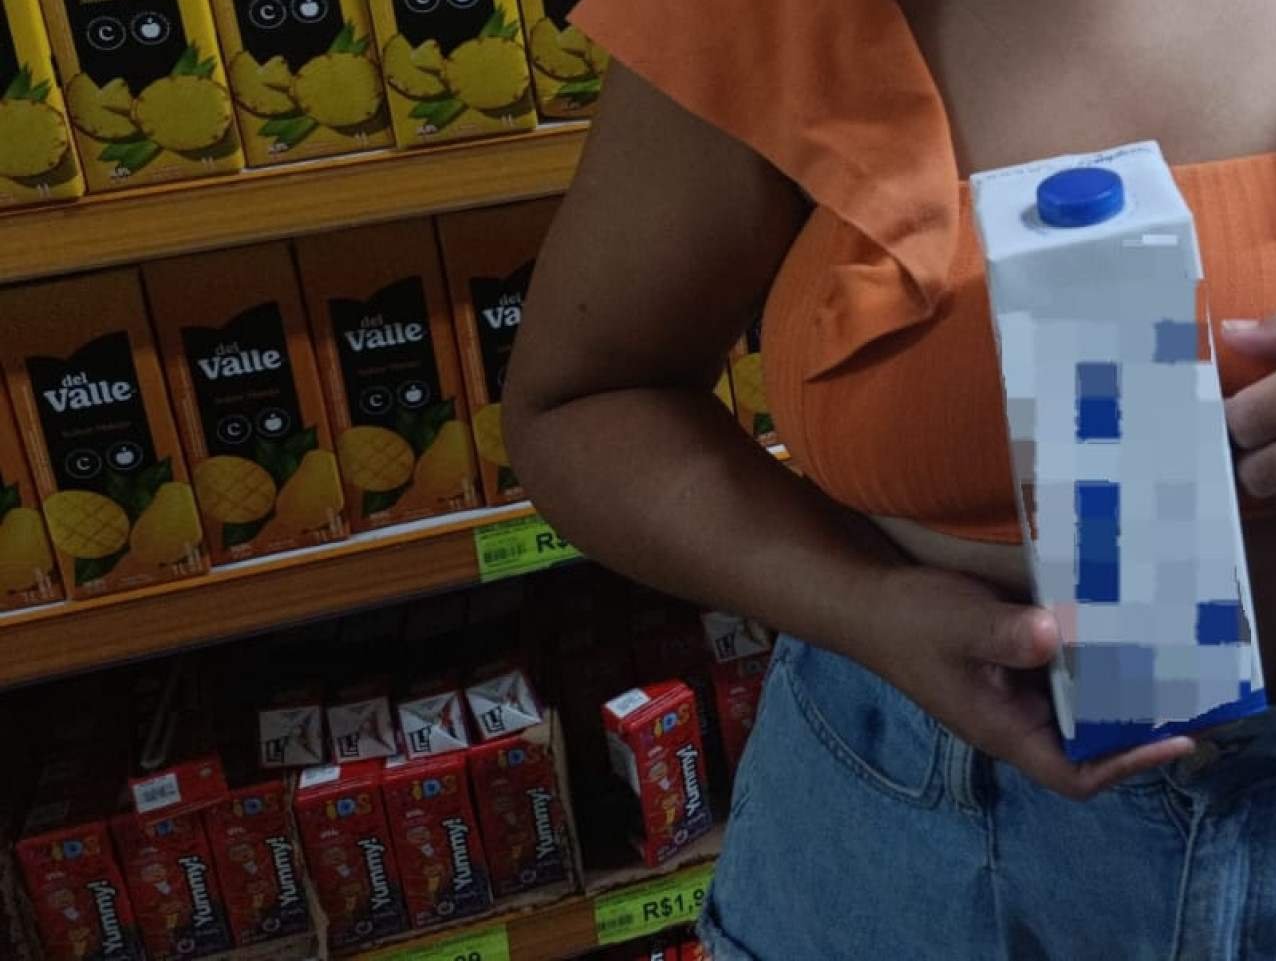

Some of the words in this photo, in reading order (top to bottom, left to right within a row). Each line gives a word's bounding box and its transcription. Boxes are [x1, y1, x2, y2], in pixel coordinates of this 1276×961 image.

[345, 322, 424, 352] Valle
[61, 371, 88, 388] del
[198, 348, 282, 381] Valle
[43, 380, 132, 412] Valle
[526, 786, 557, 860] Yummy!
[442, 816, 474, 891] Yummy!
[265, 836, 299, 907] Yummy!
[177, 855, 213, 927] Yummy!
[642, 888, 705, 922] R$1,9
